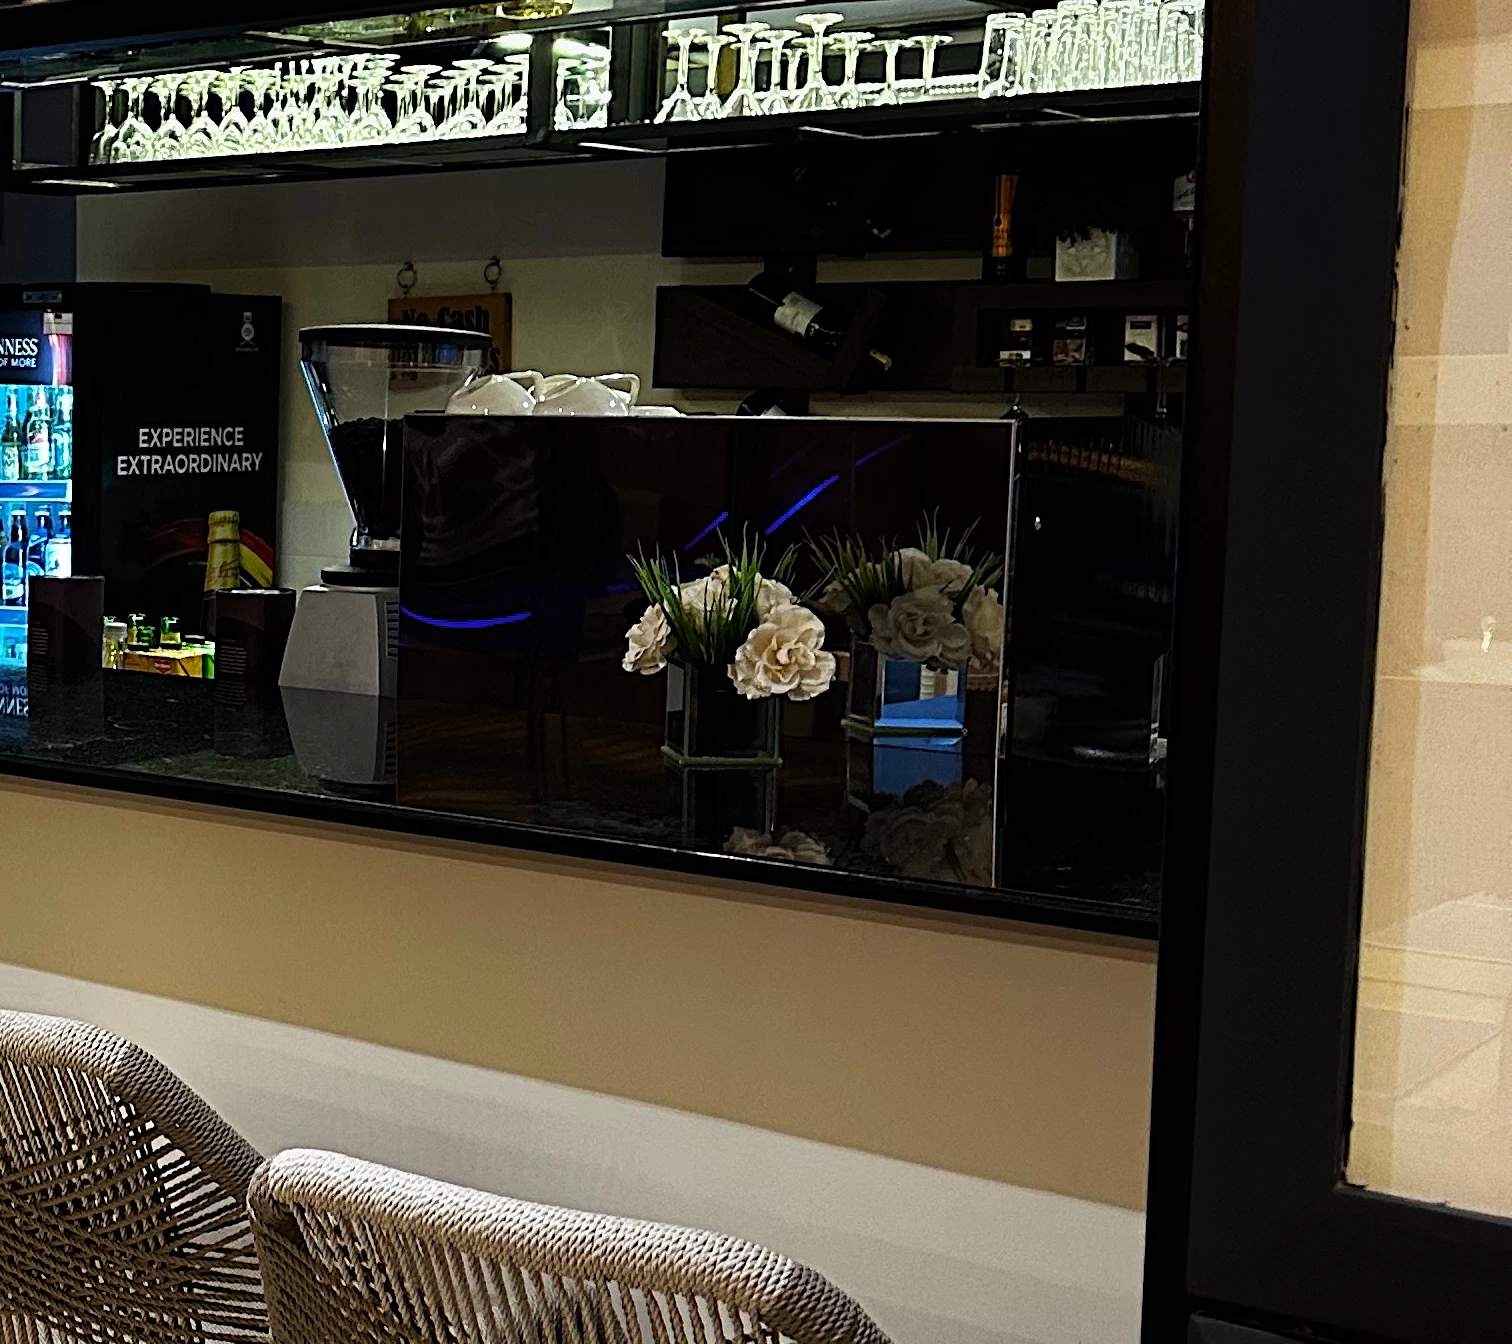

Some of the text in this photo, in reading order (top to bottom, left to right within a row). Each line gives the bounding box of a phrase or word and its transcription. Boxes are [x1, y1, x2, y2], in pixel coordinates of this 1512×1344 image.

[437, 305, 490, 333] Cash
[11, 357, 37, 368] MORE
[138, 426, 245, 448] EXPERIENCE
[116, 452, 263, 476] EXTRAORDINARY
